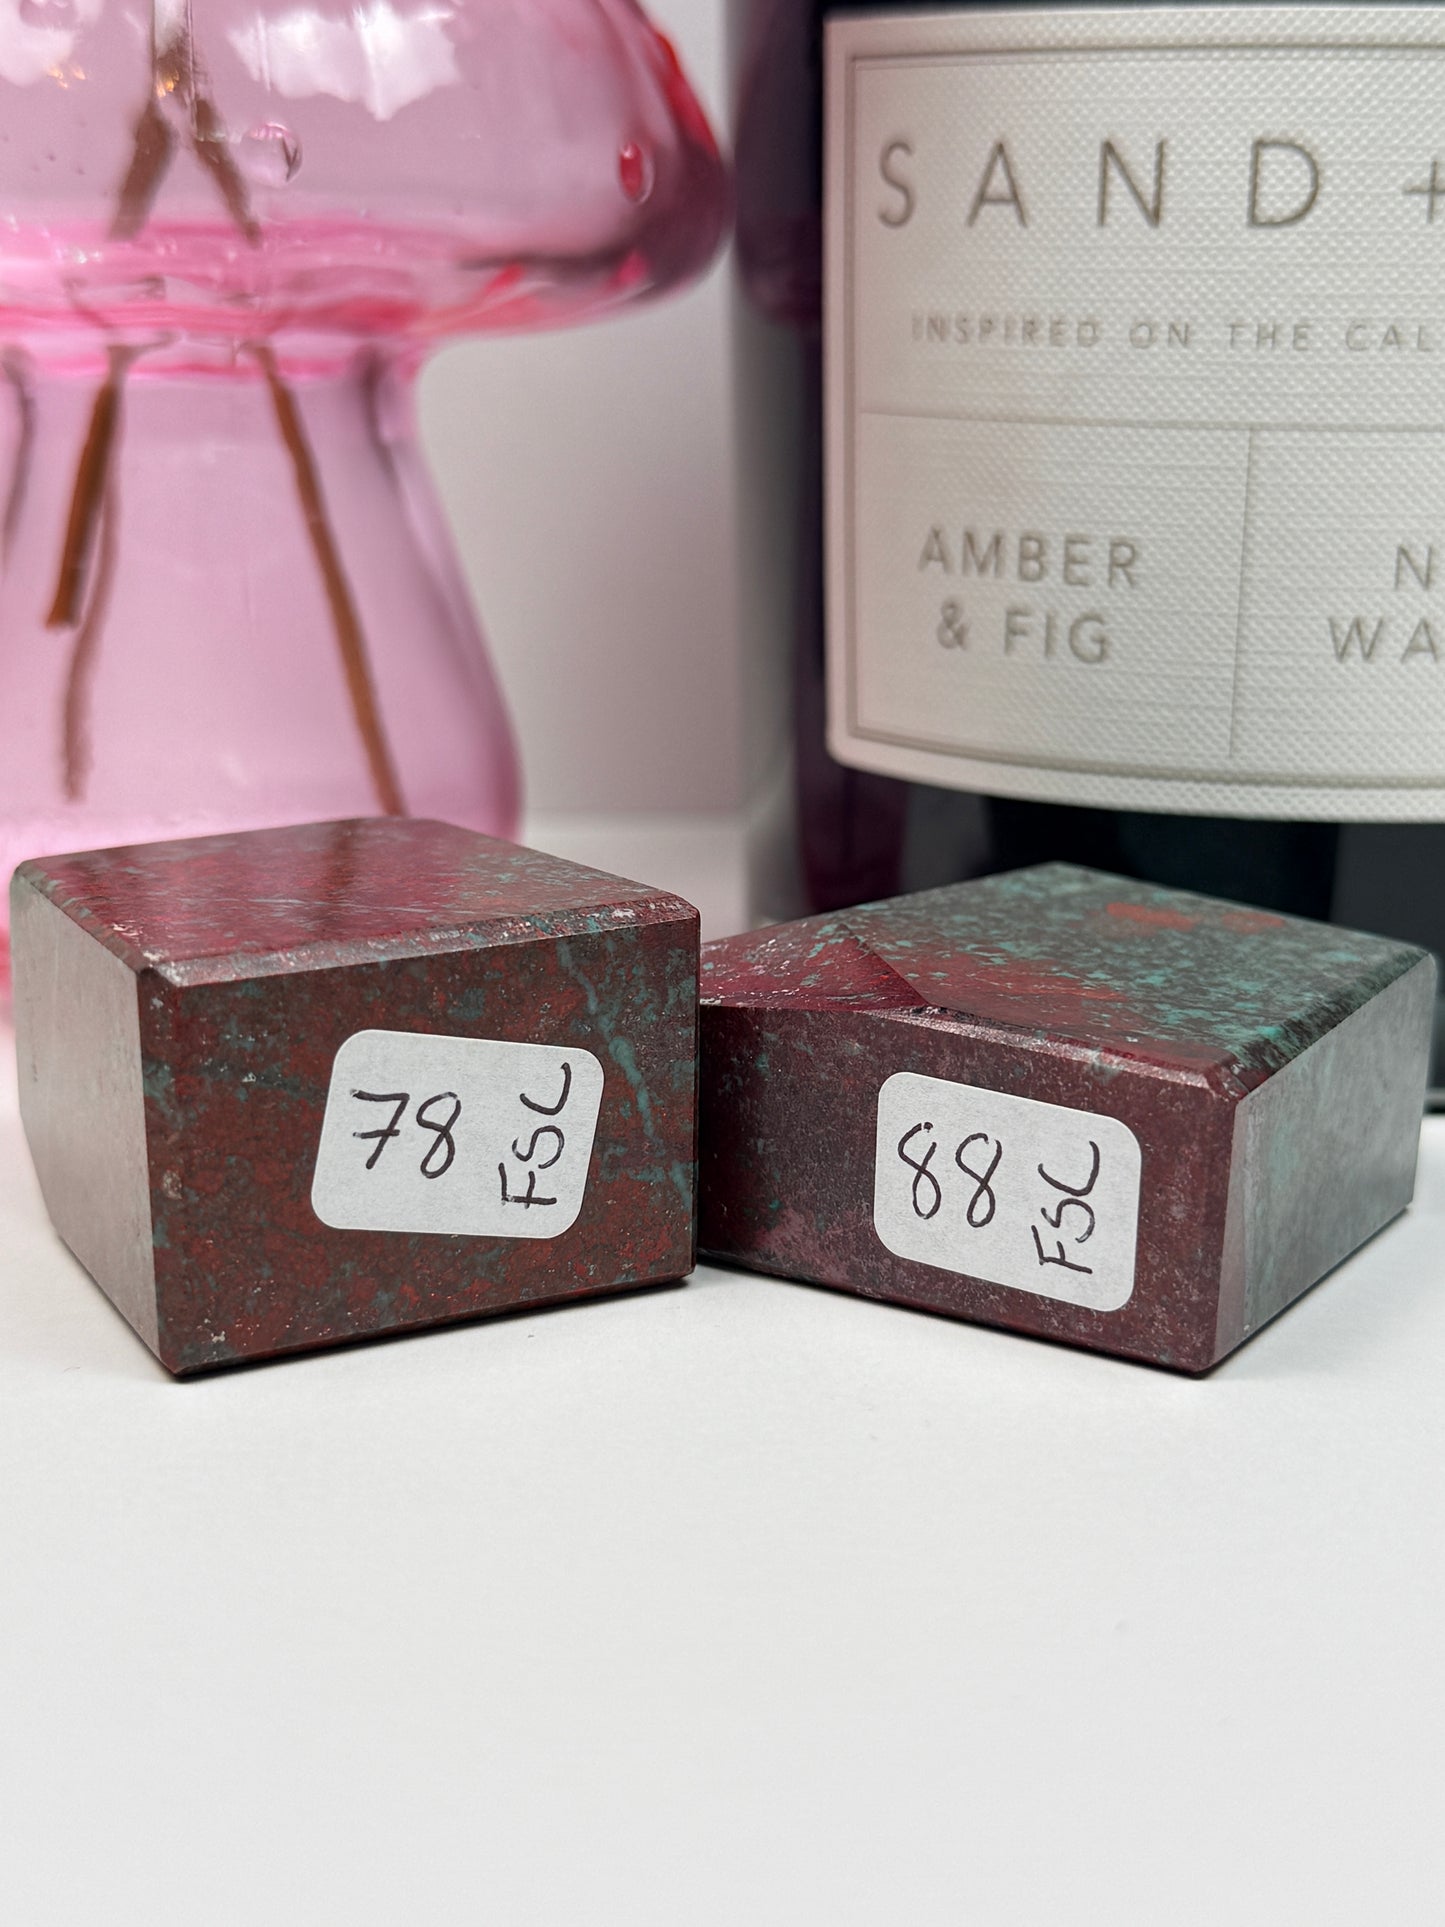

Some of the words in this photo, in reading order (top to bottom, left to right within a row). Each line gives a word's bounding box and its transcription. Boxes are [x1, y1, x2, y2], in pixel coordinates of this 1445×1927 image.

[876, 138, 1322, 229] SAND
[911, 314, 1101, 349] INSPIRED
[1128, 321, 1191, 350] ON
[1228, 322, 1309, 352] THE
[1345, 323, 1433, 353] CAL
[917, 525, 1141, 588] AMBER
[1394, 543, 1435, 592] N
[936, 601, 968, 651] &
[1004, 606, 1112, 664] FIG
[1327, 615, 1439, 664] WA
[350, 1089, 462, 1180] 78
[897, 1121, 1003, 1228] 88
